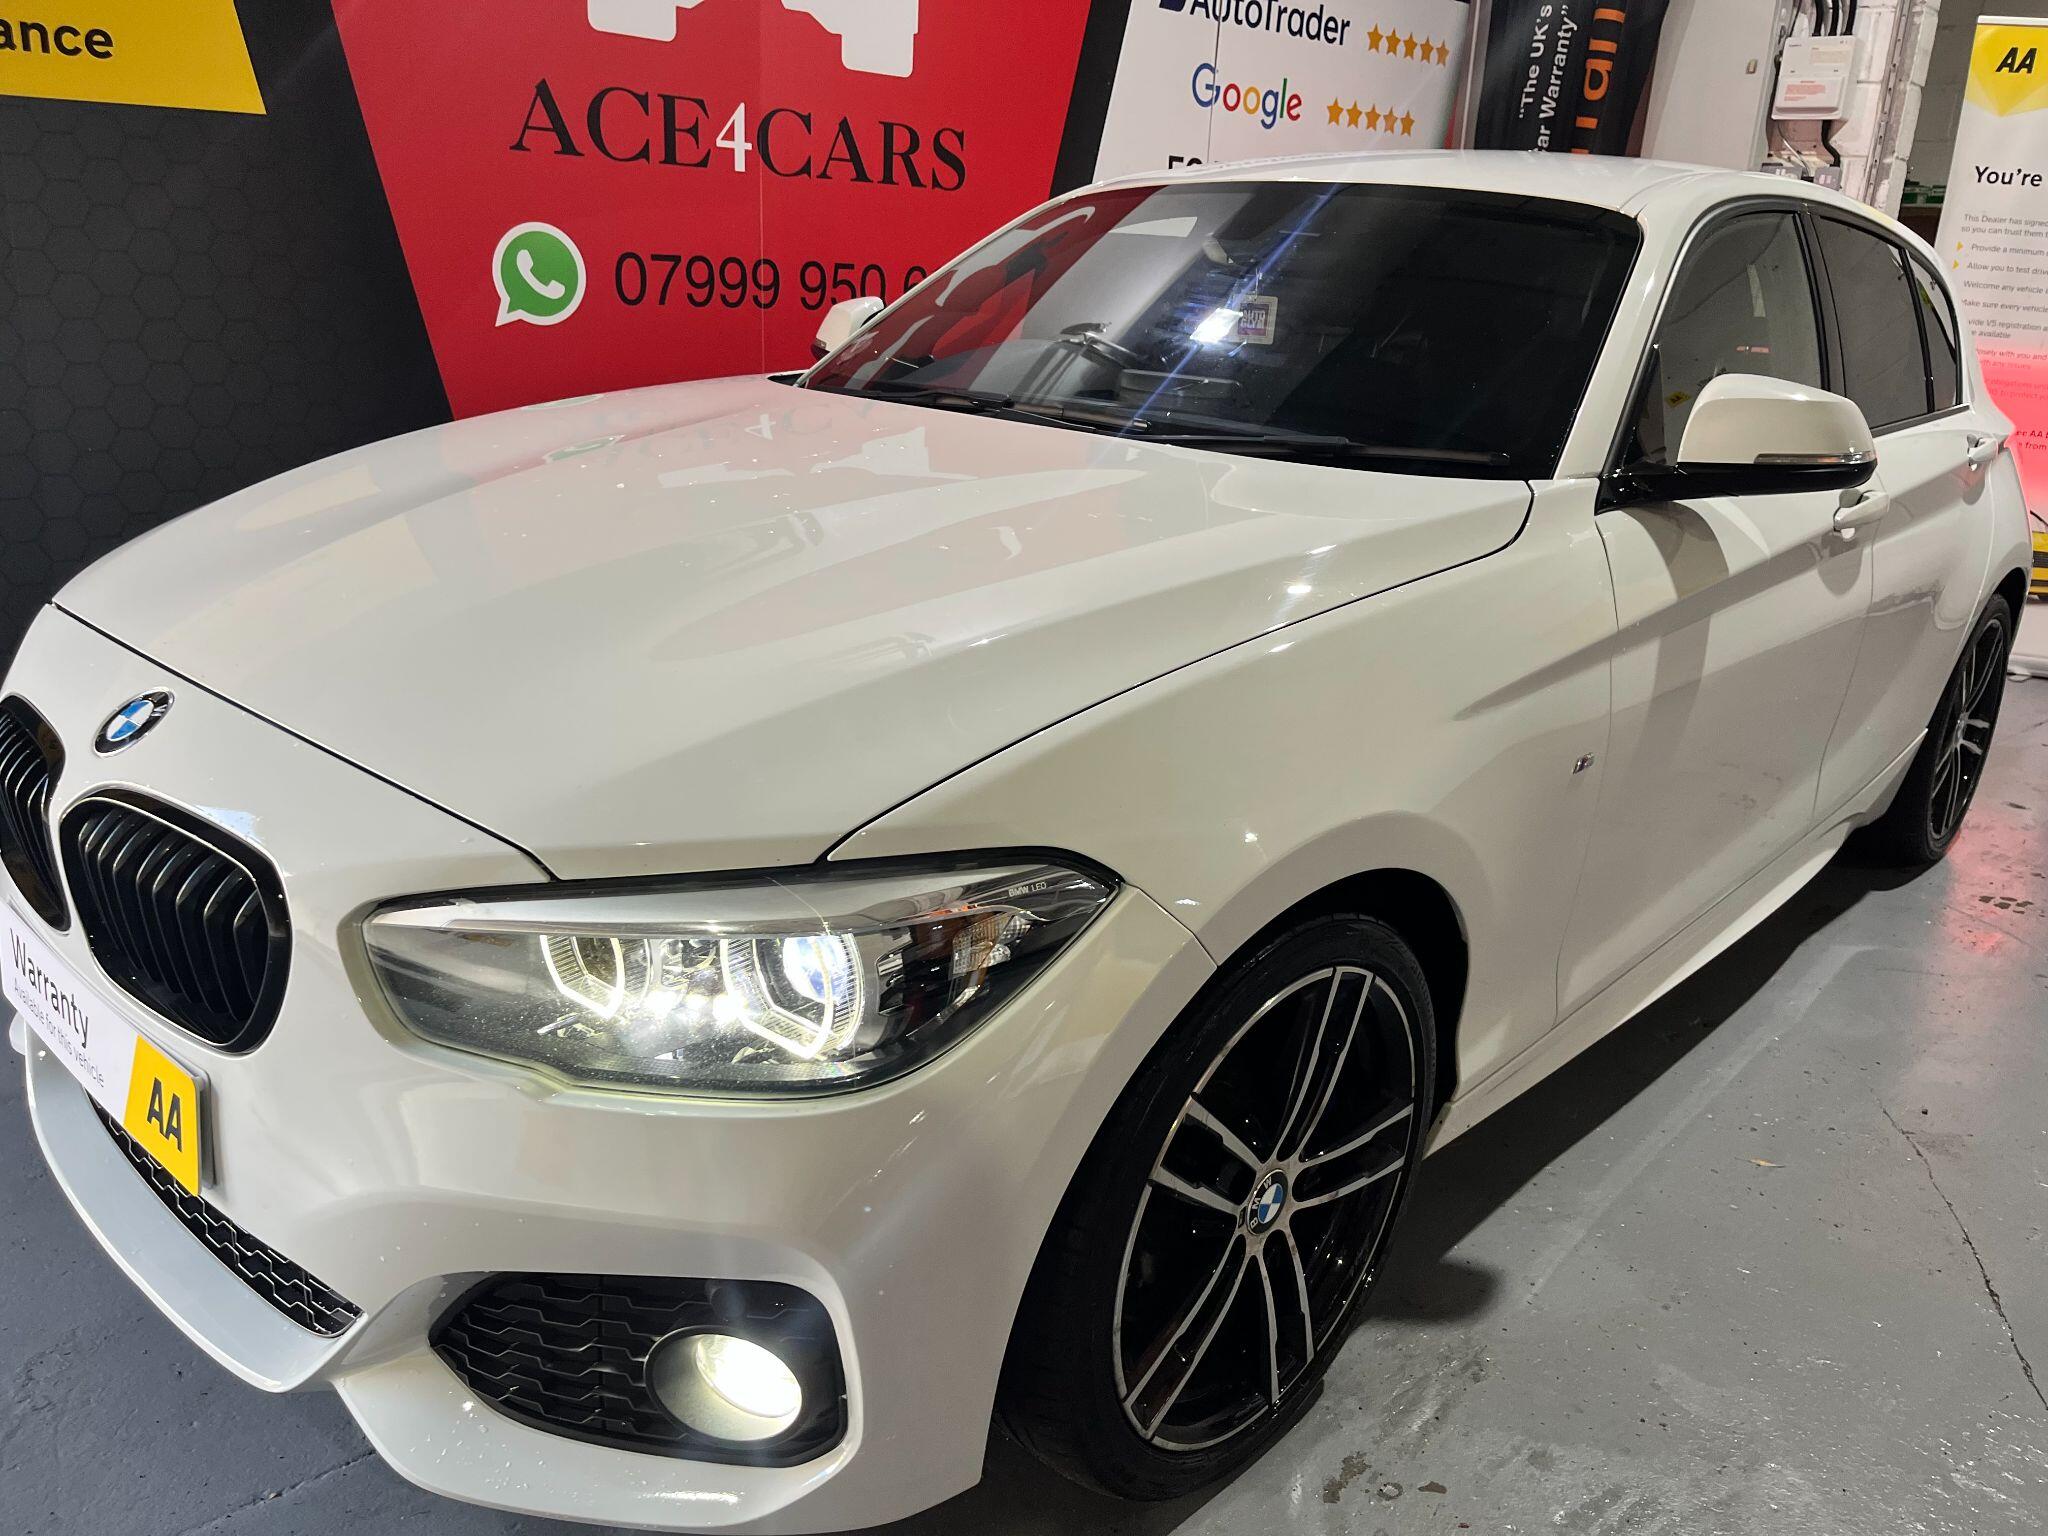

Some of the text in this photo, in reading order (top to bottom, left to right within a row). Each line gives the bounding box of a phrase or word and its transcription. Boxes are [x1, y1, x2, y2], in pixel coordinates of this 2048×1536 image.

[1530, 4, 1553, 58] UK’s
[1995, 46, 2038, 74] AA
[1191, 62, 1303, 130] Google
[508, 77, 967, 192] ACE4CARS
[1975, 165, 2043, 187] You’re
[1971, 227, 1987, 235] you
[2004, 228, 2022, 237] trust
[2024, 229, 2044, 238] them
[2008, 217, 2023, 226] has
[1971, 243, 2001, 253] Provide
[2009, 246, 2045, 256] minimum
[1967, 261, 1990, 270] Allow
[1990, 263, 2005, 272] you
[614, 252, 781, 309] 07999
[800, 261, 886, 311] 950
[2001, 283, 2016, 293] any
[10, 928, 89, 1049] Warranty
[147, 1077, 183, 1153] AA
